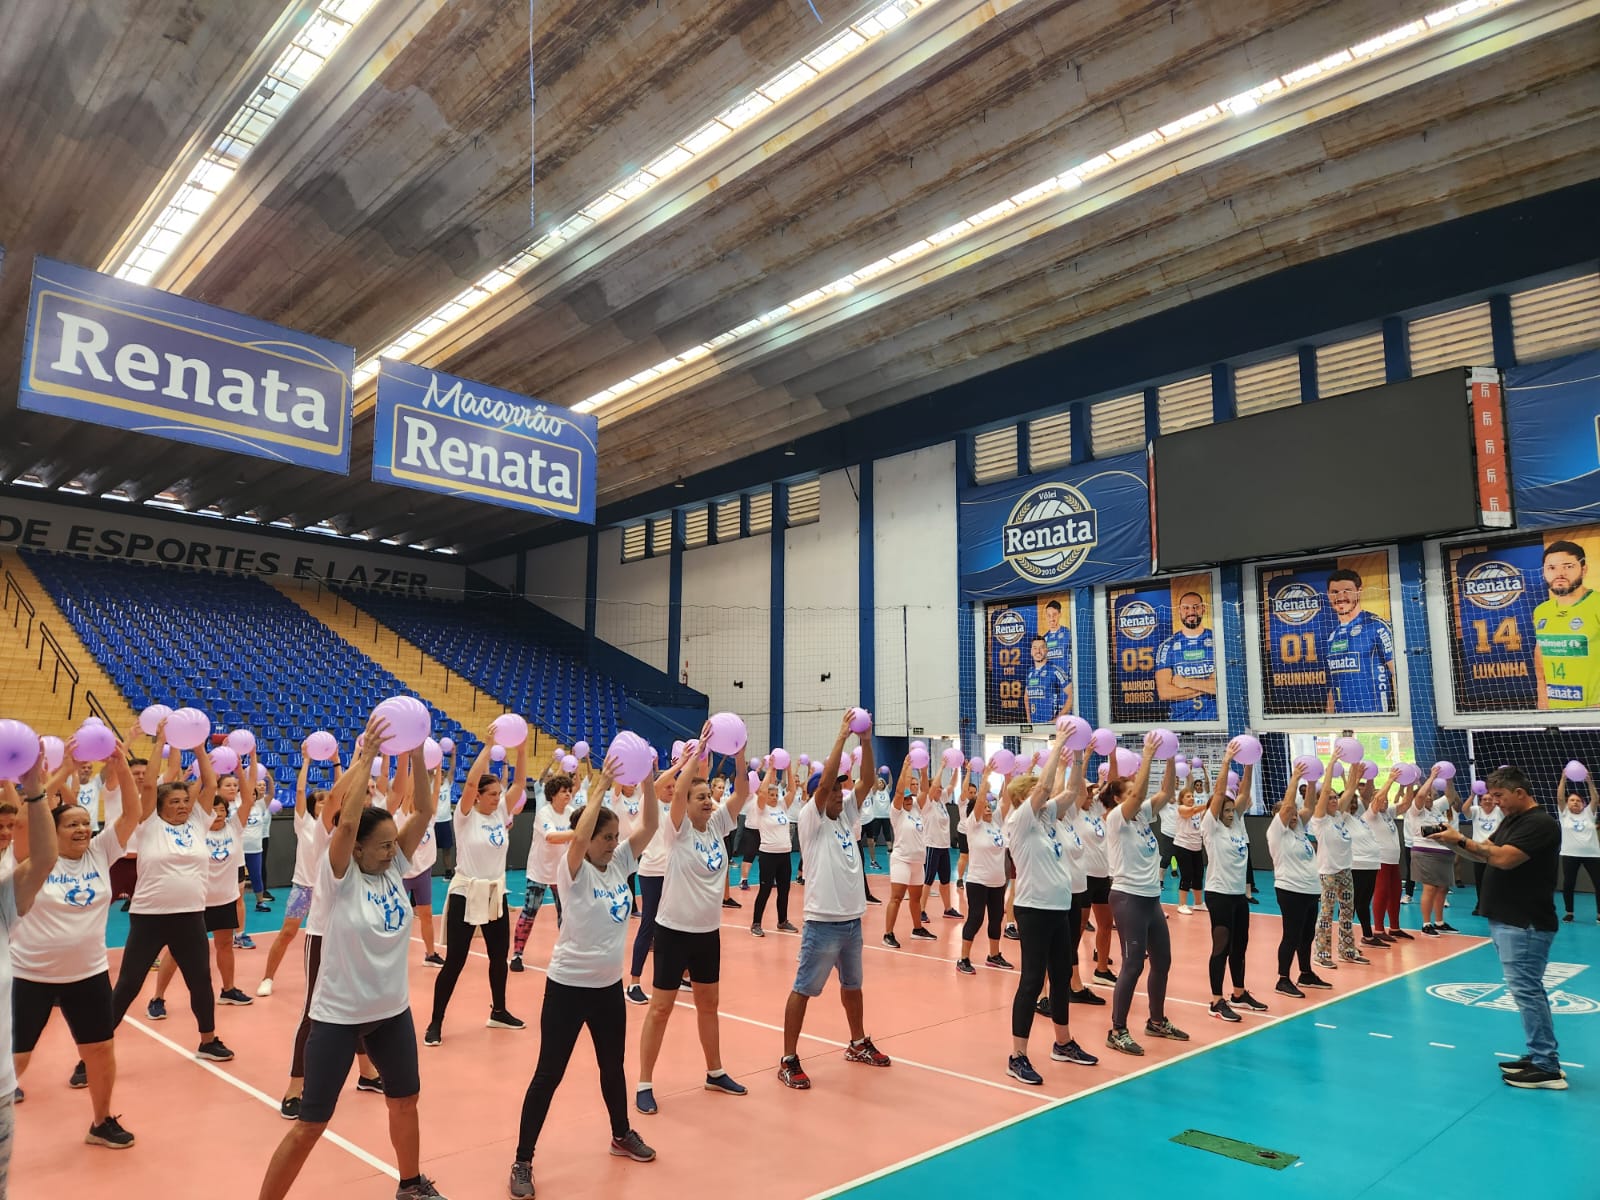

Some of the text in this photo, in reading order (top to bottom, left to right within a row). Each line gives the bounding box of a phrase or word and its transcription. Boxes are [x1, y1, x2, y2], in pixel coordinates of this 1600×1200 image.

[50, 311, 329, 432] Renata
[422, 373, 567, 437] Macarrão
[401, 415, 573, 500] Renata
[1038, 490, 1058, 500] Vôlei
[1006, 518, 1093, 553] Renata
[67, 525, 280, 575] ESPORTES
[293, 557, 314, 580] E
[327, 561, 428, 595] LAZER
[1041, 568, 1056, 576] 2010
[1465, 578, 1522, 595] Renata
[1275, 599, 1319, 611] Renata
[995, 624, 1025, 635] Renata
[1120, 615, 1156, 628] Renata
[1473, 616, 1522, 653] 14
[998, 648, 1021, 666] 02
[1280, 632, 1318, 664] 01
[1121, 646, 1154, 673] 05
[1176, 663, 1215, 676] Renata
[1273, 670, 1326, 687] BRUNINHO
[1377, 665, 1387, 691] PUC
[1473, 661, 1528, 679] LUKINHA
[1551, 662, 1566, 680] 14
[1000, 681, 1022, 699] 08
